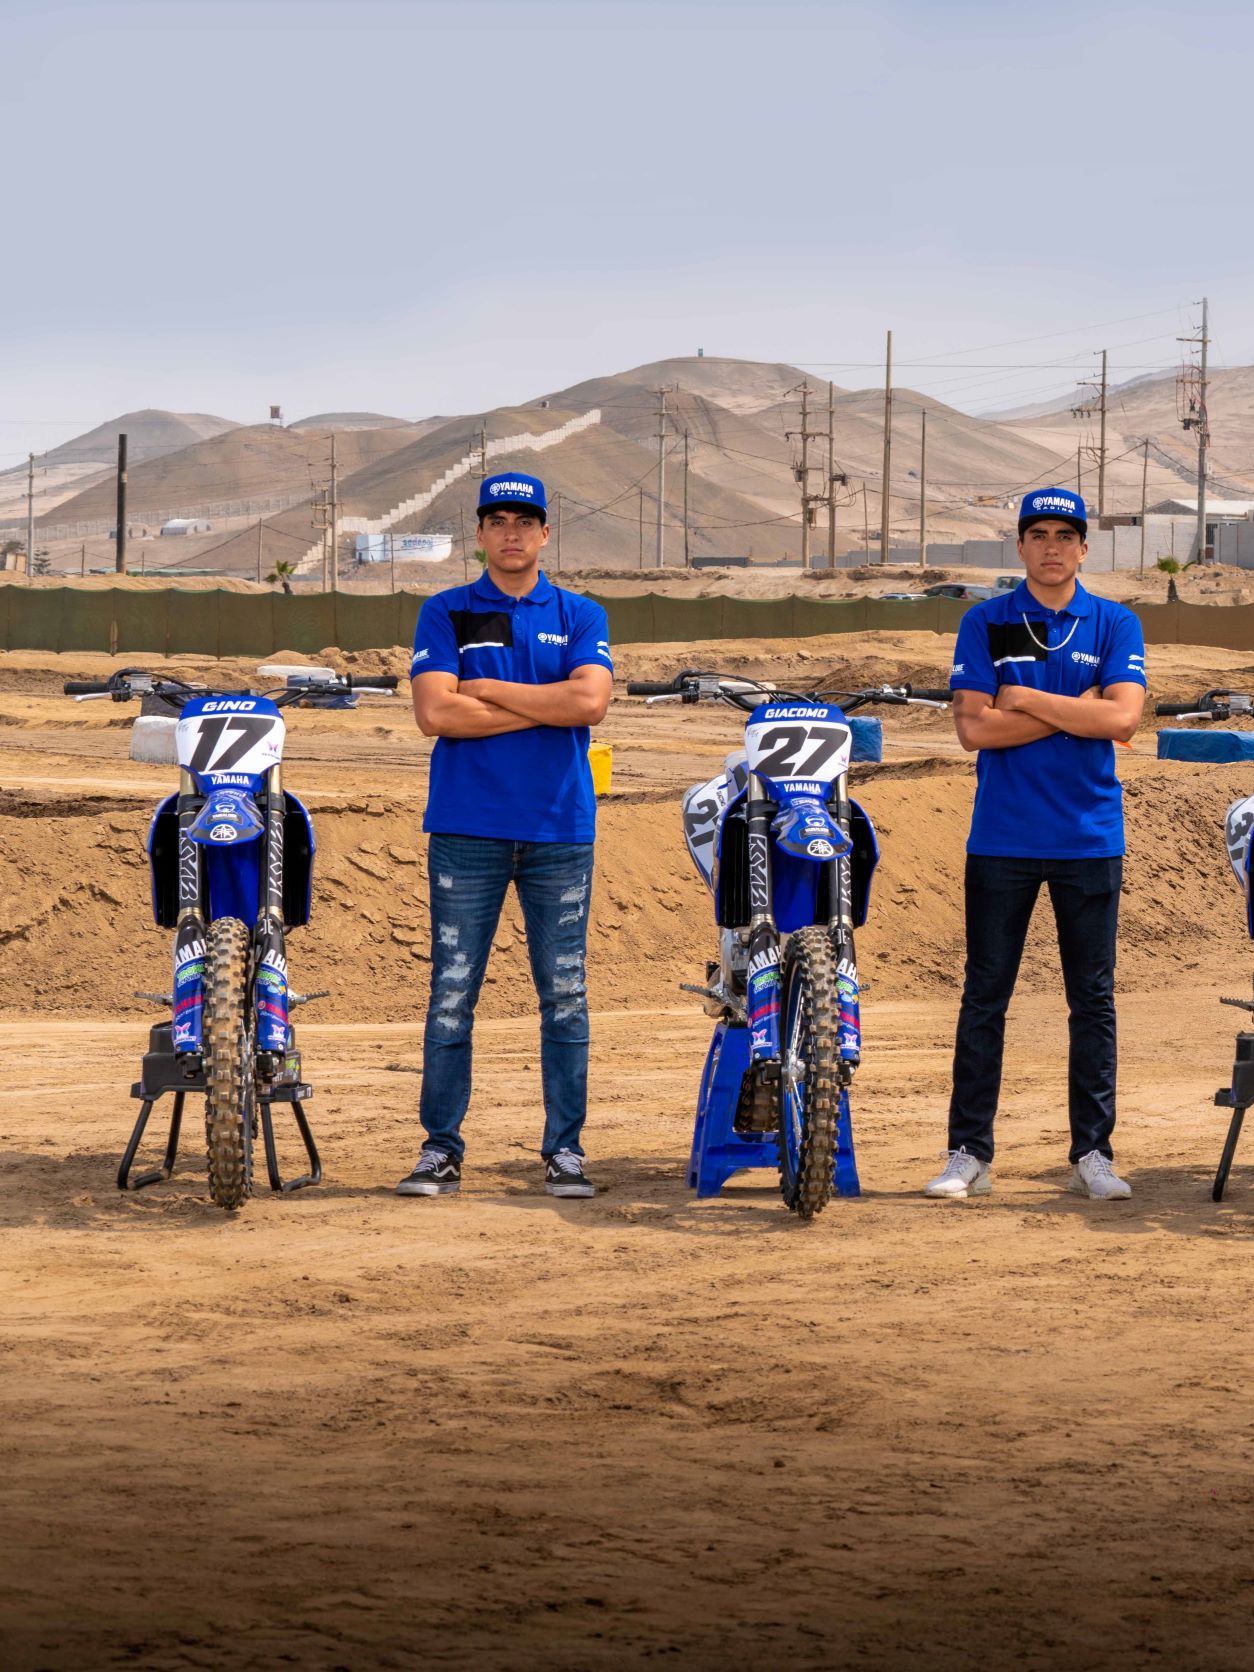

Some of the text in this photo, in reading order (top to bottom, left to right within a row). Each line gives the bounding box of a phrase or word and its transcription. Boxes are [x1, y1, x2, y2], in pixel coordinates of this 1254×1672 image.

[500, 482, 534, 494] YAMAHA
[1043, 497, 1076, 510] YAMAHA
[201, 701, 257, 712] GINO
[764, 707, 829, 719] GIACOMO
[189, 716, 276, 772] 17
[754, 726, 849, 777] 27
[211, 775, 250, 785] YAMAHA
[783, 782, 822, 793] YAMAHA
[748, 833, 769, 906] KYB
